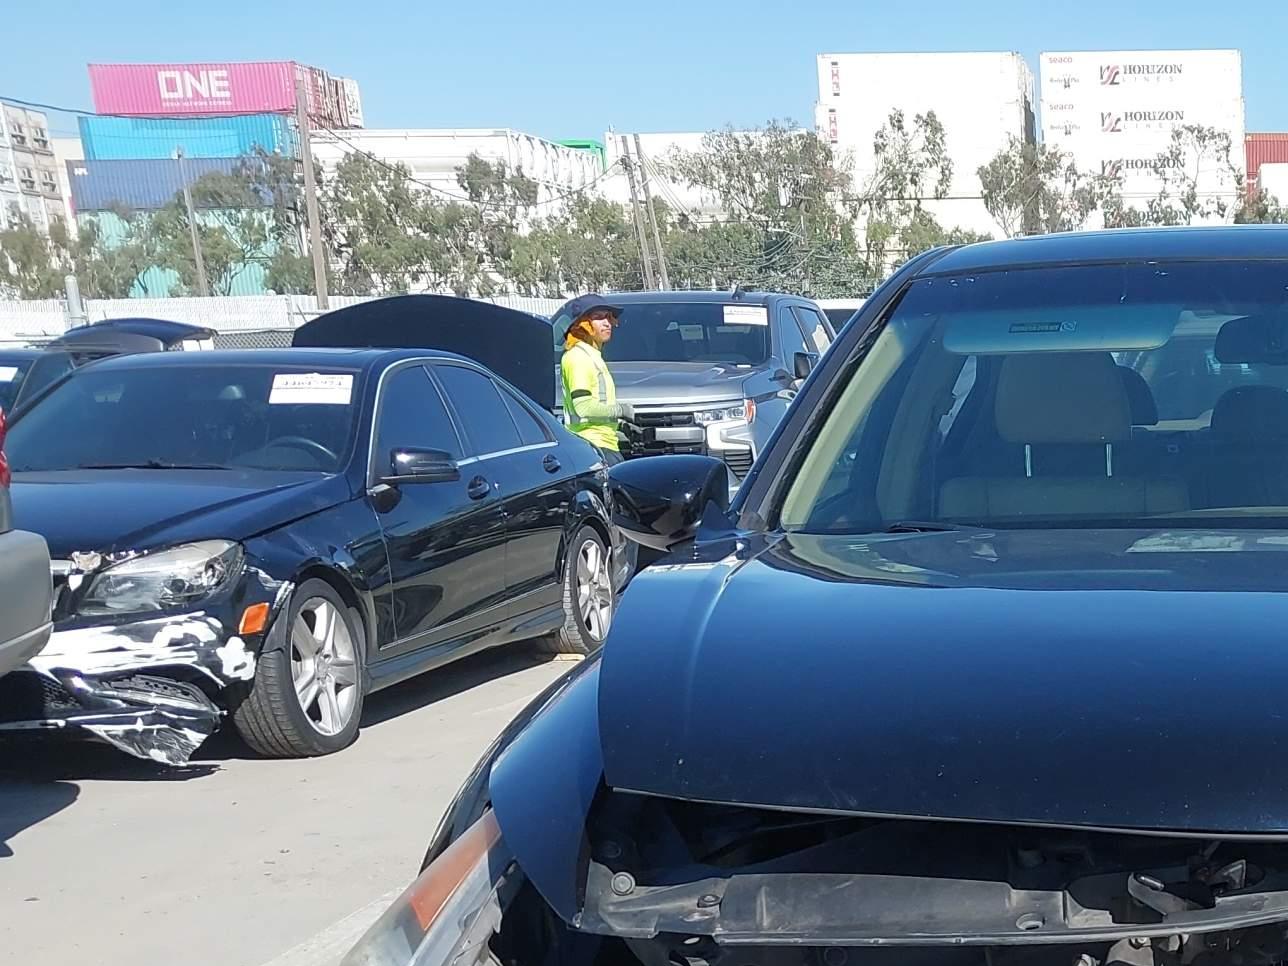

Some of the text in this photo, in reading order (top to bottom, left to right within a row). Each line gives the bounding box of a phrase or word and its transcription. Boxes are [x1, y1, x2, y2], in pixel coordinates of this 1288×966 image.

[1122, 64, 1183, 75] HORIZON
[158, 70, 231, 98] ONE
[1124, 111, 1185, 121] HORIZON
